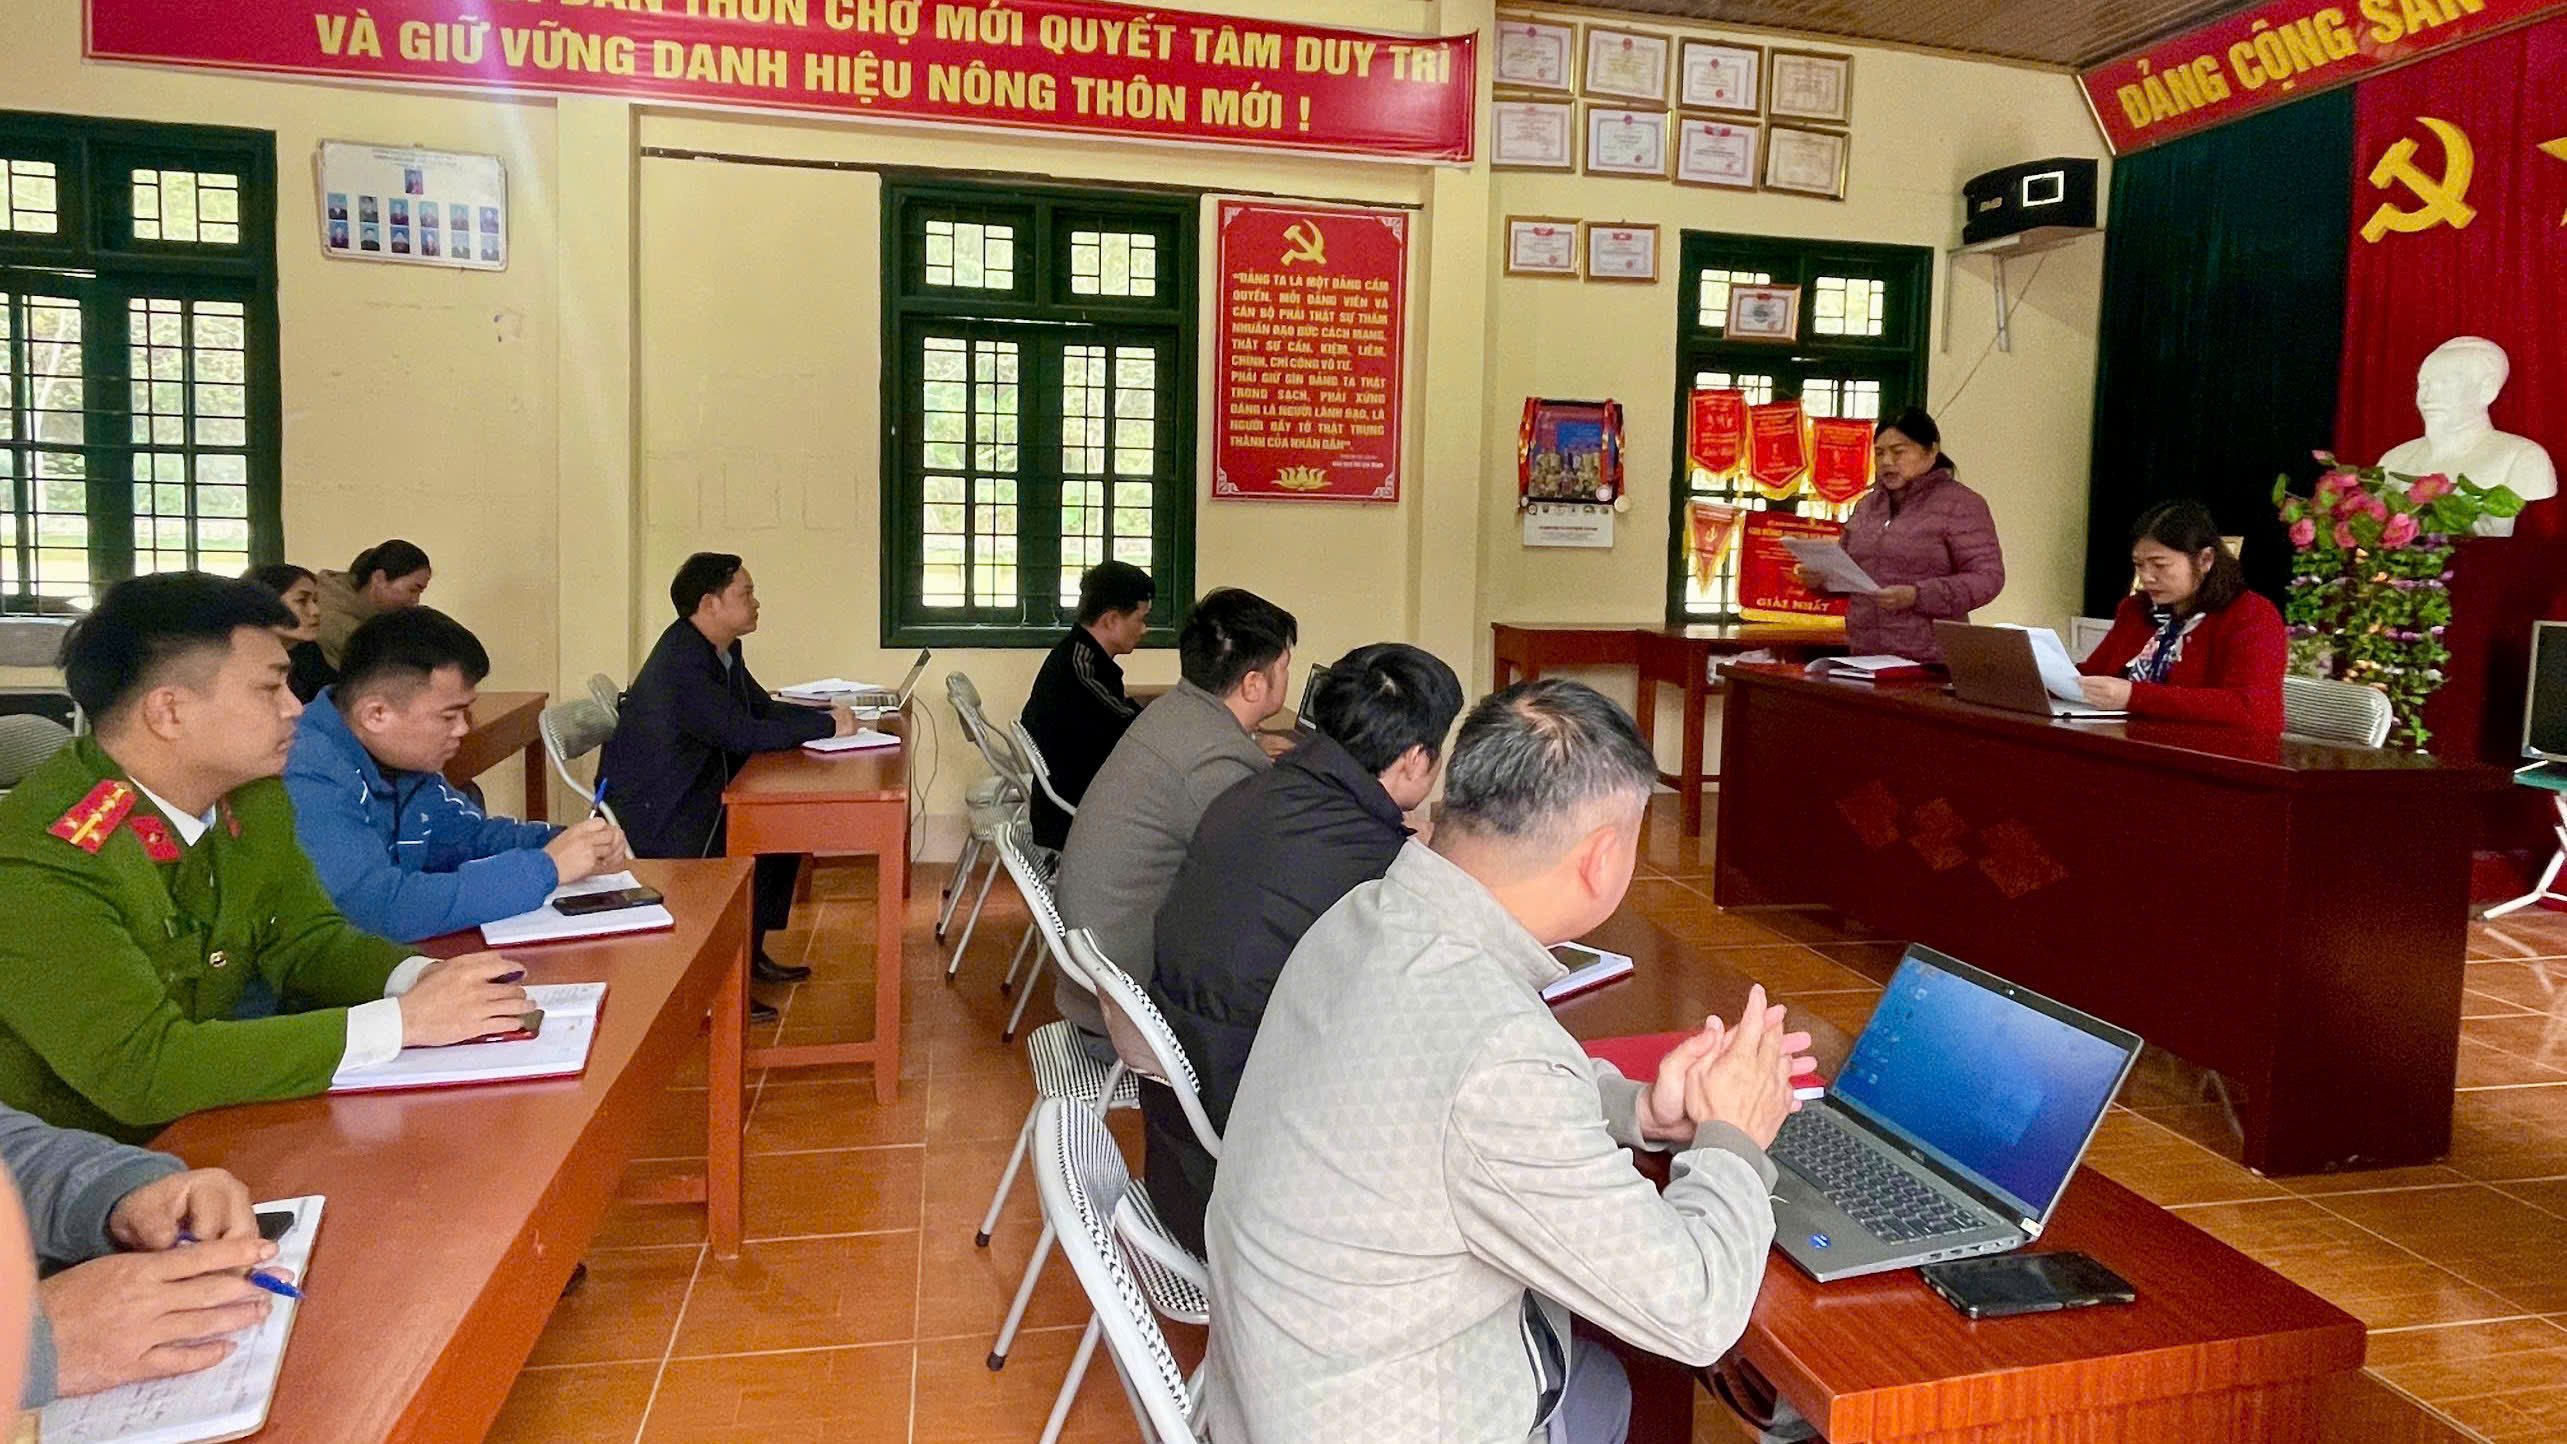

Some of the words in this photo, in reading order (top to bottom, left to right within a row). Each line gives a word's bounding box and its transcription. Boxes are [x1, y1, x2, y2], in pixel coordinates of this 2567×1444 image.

[315, 8, 383, 58] VÀ
[399, 15, 491, 64] GIỮ
[500, 20, 635, 76] VỮNG
[653, 39, 788, 89] DANH
[805, 50, 912, 104] HIỆU
[928, 59, 1056, 111] NÔNG
[1071, 74, 1187, 122] THÔN
[1201, 81, 1283, 129] MỚI
[1299, 96, 1310, 131] !
[825, 0, 923, 45] CHỢ
[935, 0, 1023, 46] MỚI
[1039, 13, 1177, 60] QUYẾT
[1190, 25, 1281, 69] TÂM
[1296, 36, 1376, 77] DUY
[1388, 42, 1450, 84] TRÌ
[2116, 58, 2231, 129] ĐẢNG
[2228, 7, 2358, 90] CỘNG
[1274, 274, 1286, 286] TA
